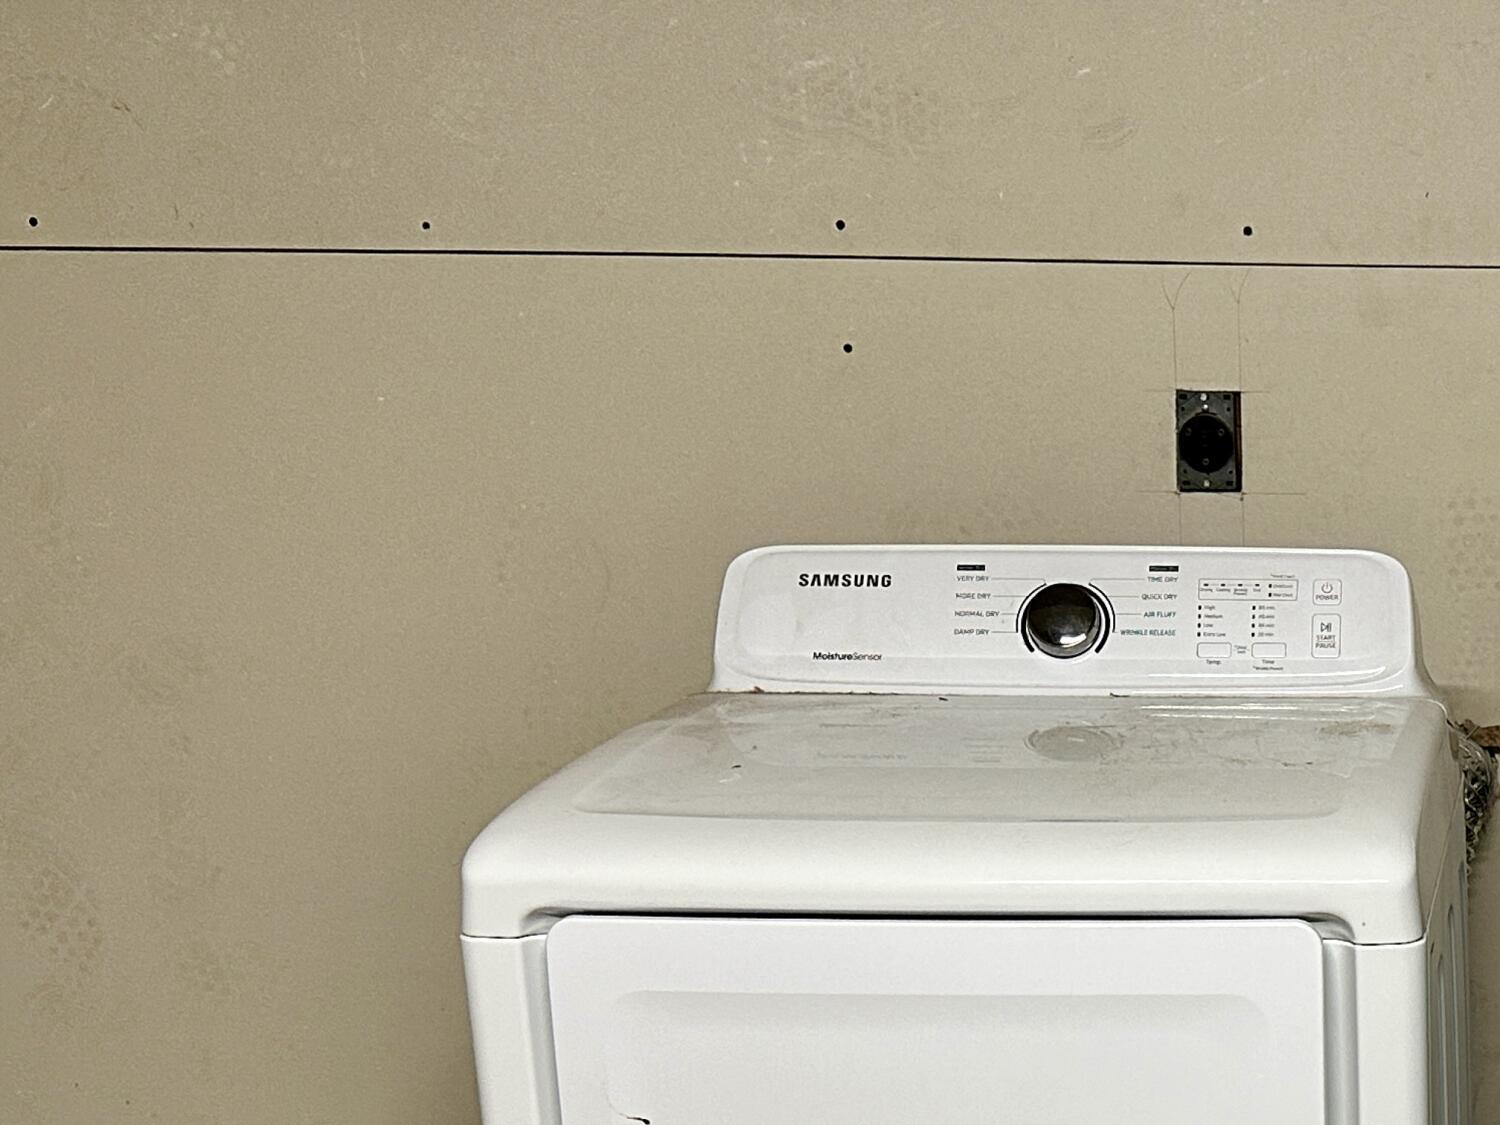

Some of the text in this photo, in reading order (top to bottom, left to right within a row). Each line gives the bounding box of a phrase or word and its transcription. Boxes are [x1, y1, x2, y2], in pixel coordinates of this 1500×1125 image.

[798, 573, 892, 588] SAMSUNG
[956, 592, 991, 600] MORE DRY
[1141, 593, 1162, 601] QUICK
[1120, 628, 1148, 636] WRINKLE
